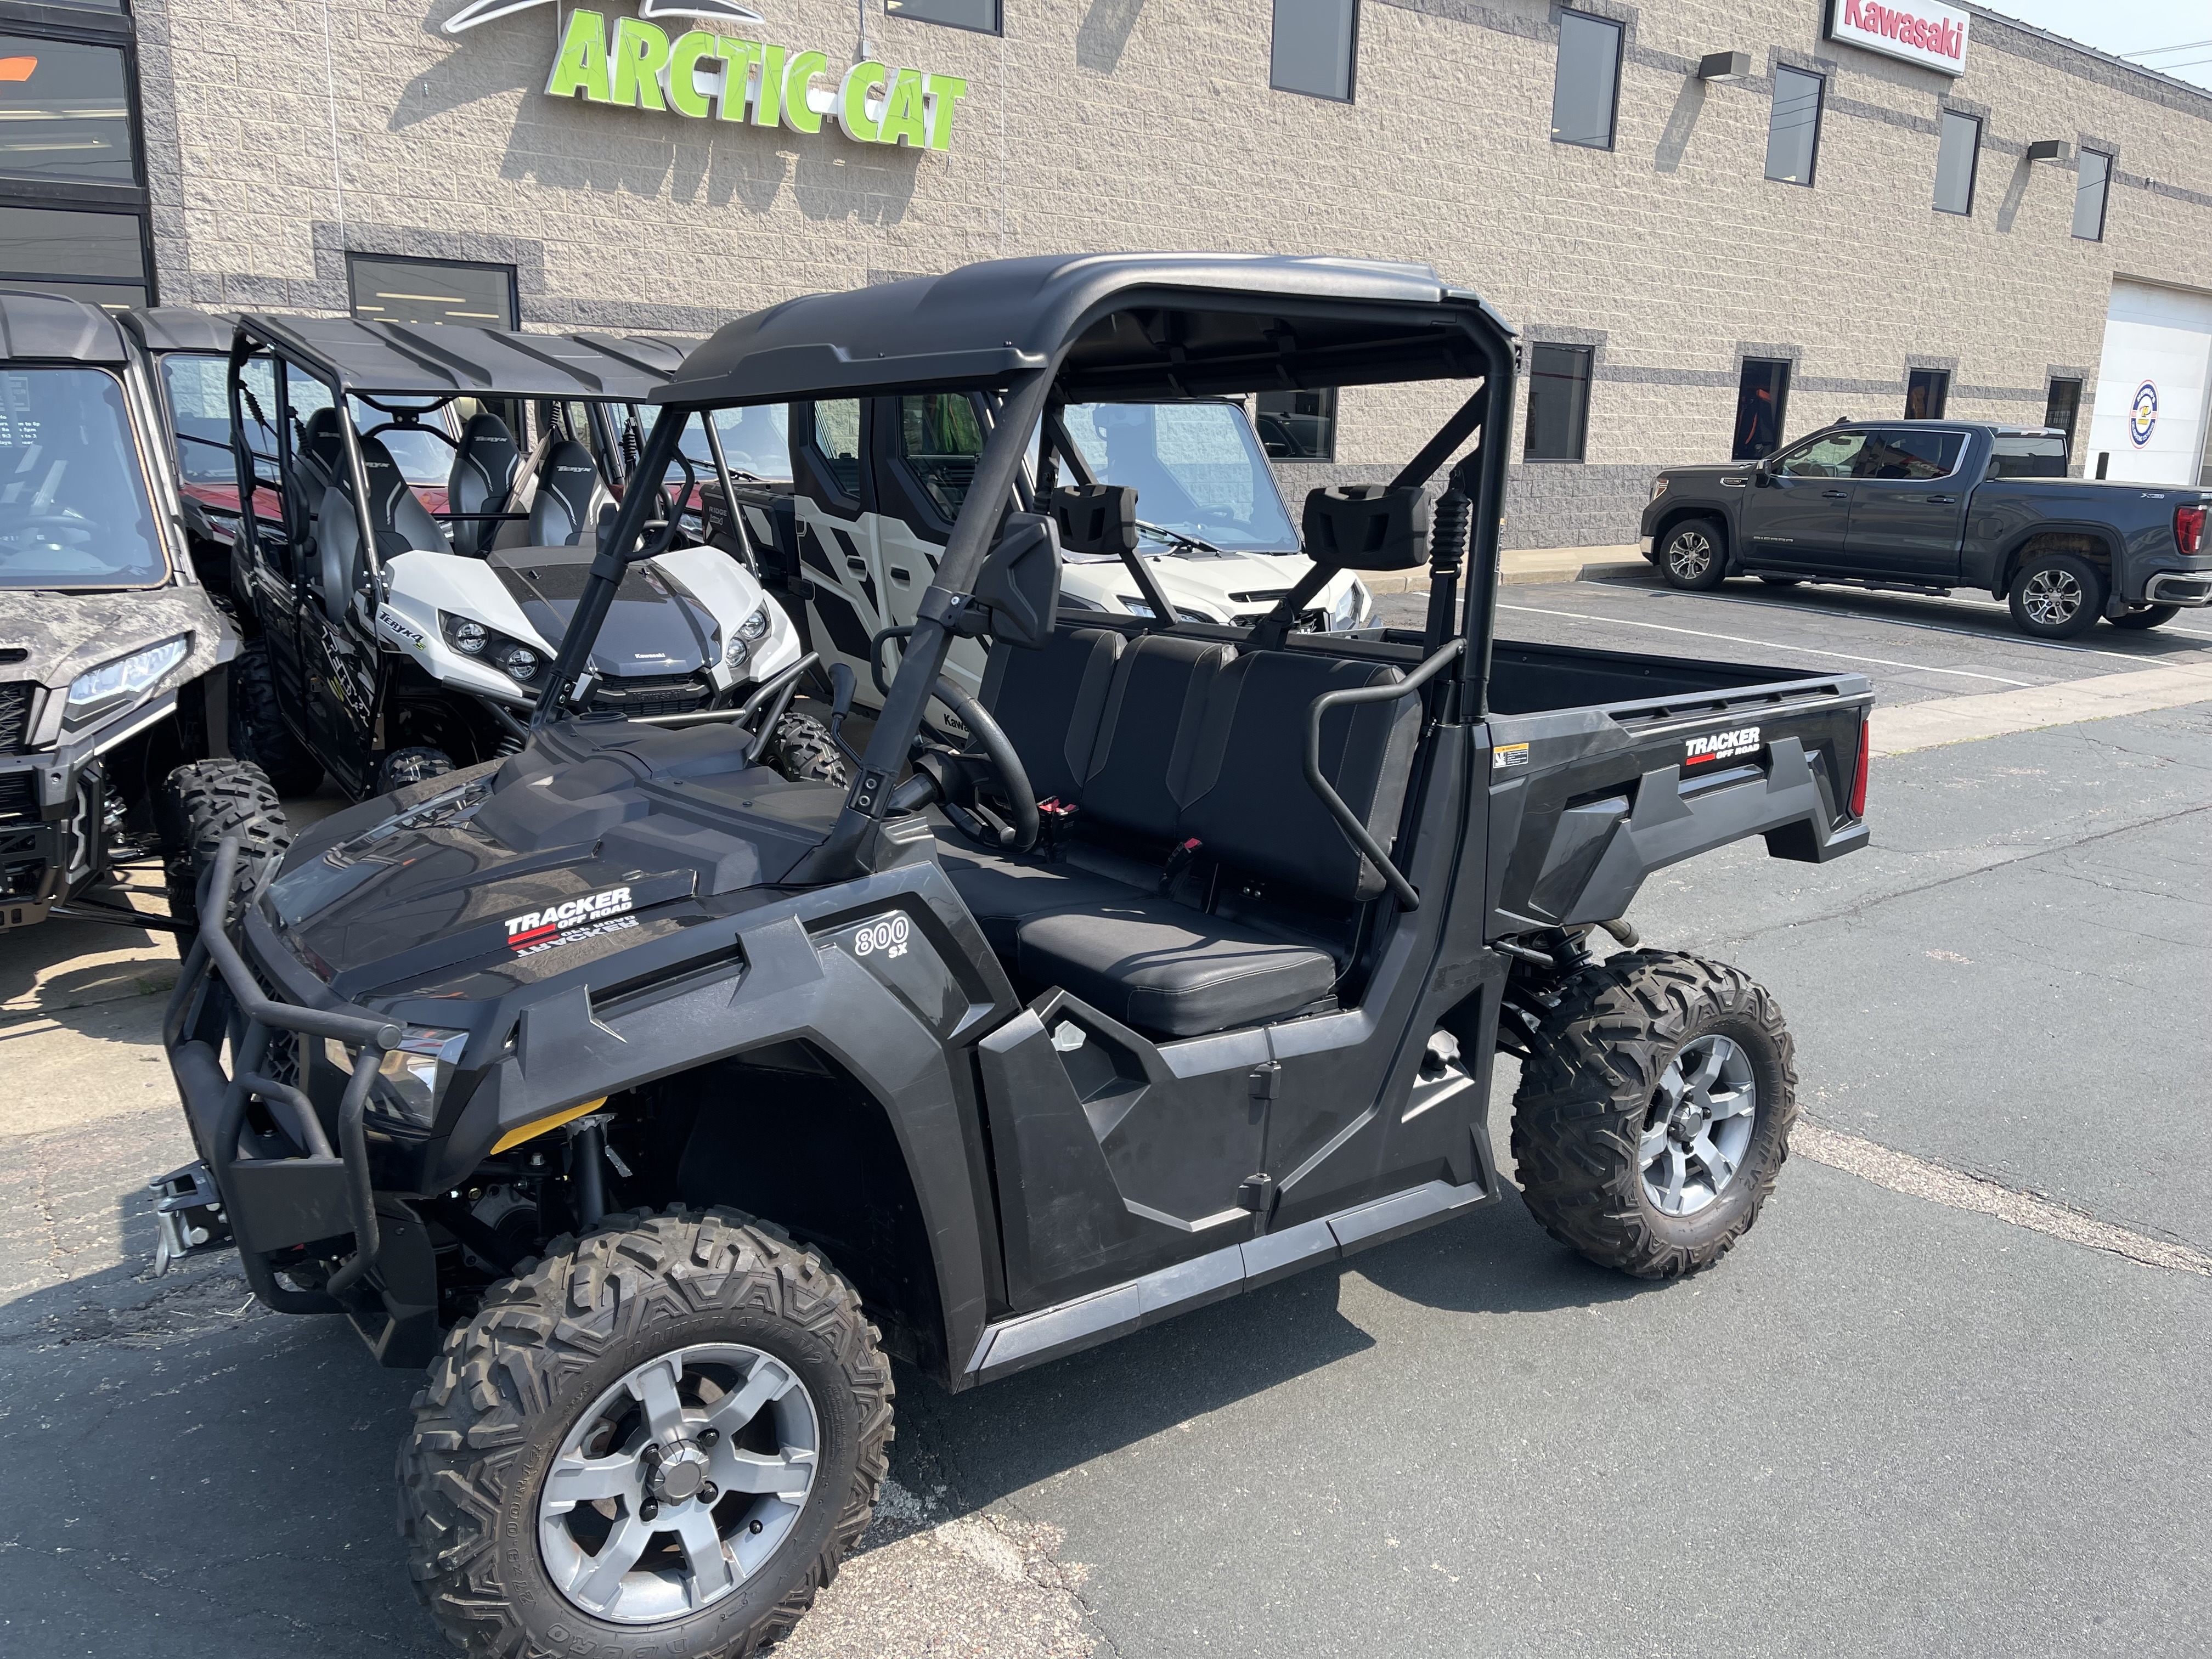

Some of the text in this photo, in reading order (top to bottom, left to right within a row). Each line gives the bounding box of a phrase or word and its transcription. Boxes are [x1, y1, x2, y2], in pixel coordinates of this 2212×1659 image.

[1844, 0, 1963, 59] Kawasaki
[545, 8, 967, 151] ARCTIC CAT
[709, 506, 727, 517] RIDGE
[944, 713, 969, 732] Kawa
[1685, 726, 1760, 757] TRACKER
[1716, 743, 1760, 759] OFF ROAD
[505, 887, 631, 935] TRACKER
[557, 902, 632, 929] OFF ROAD
[855, 916, 909, 956] 800
[888, 942, 908, 958] SX
